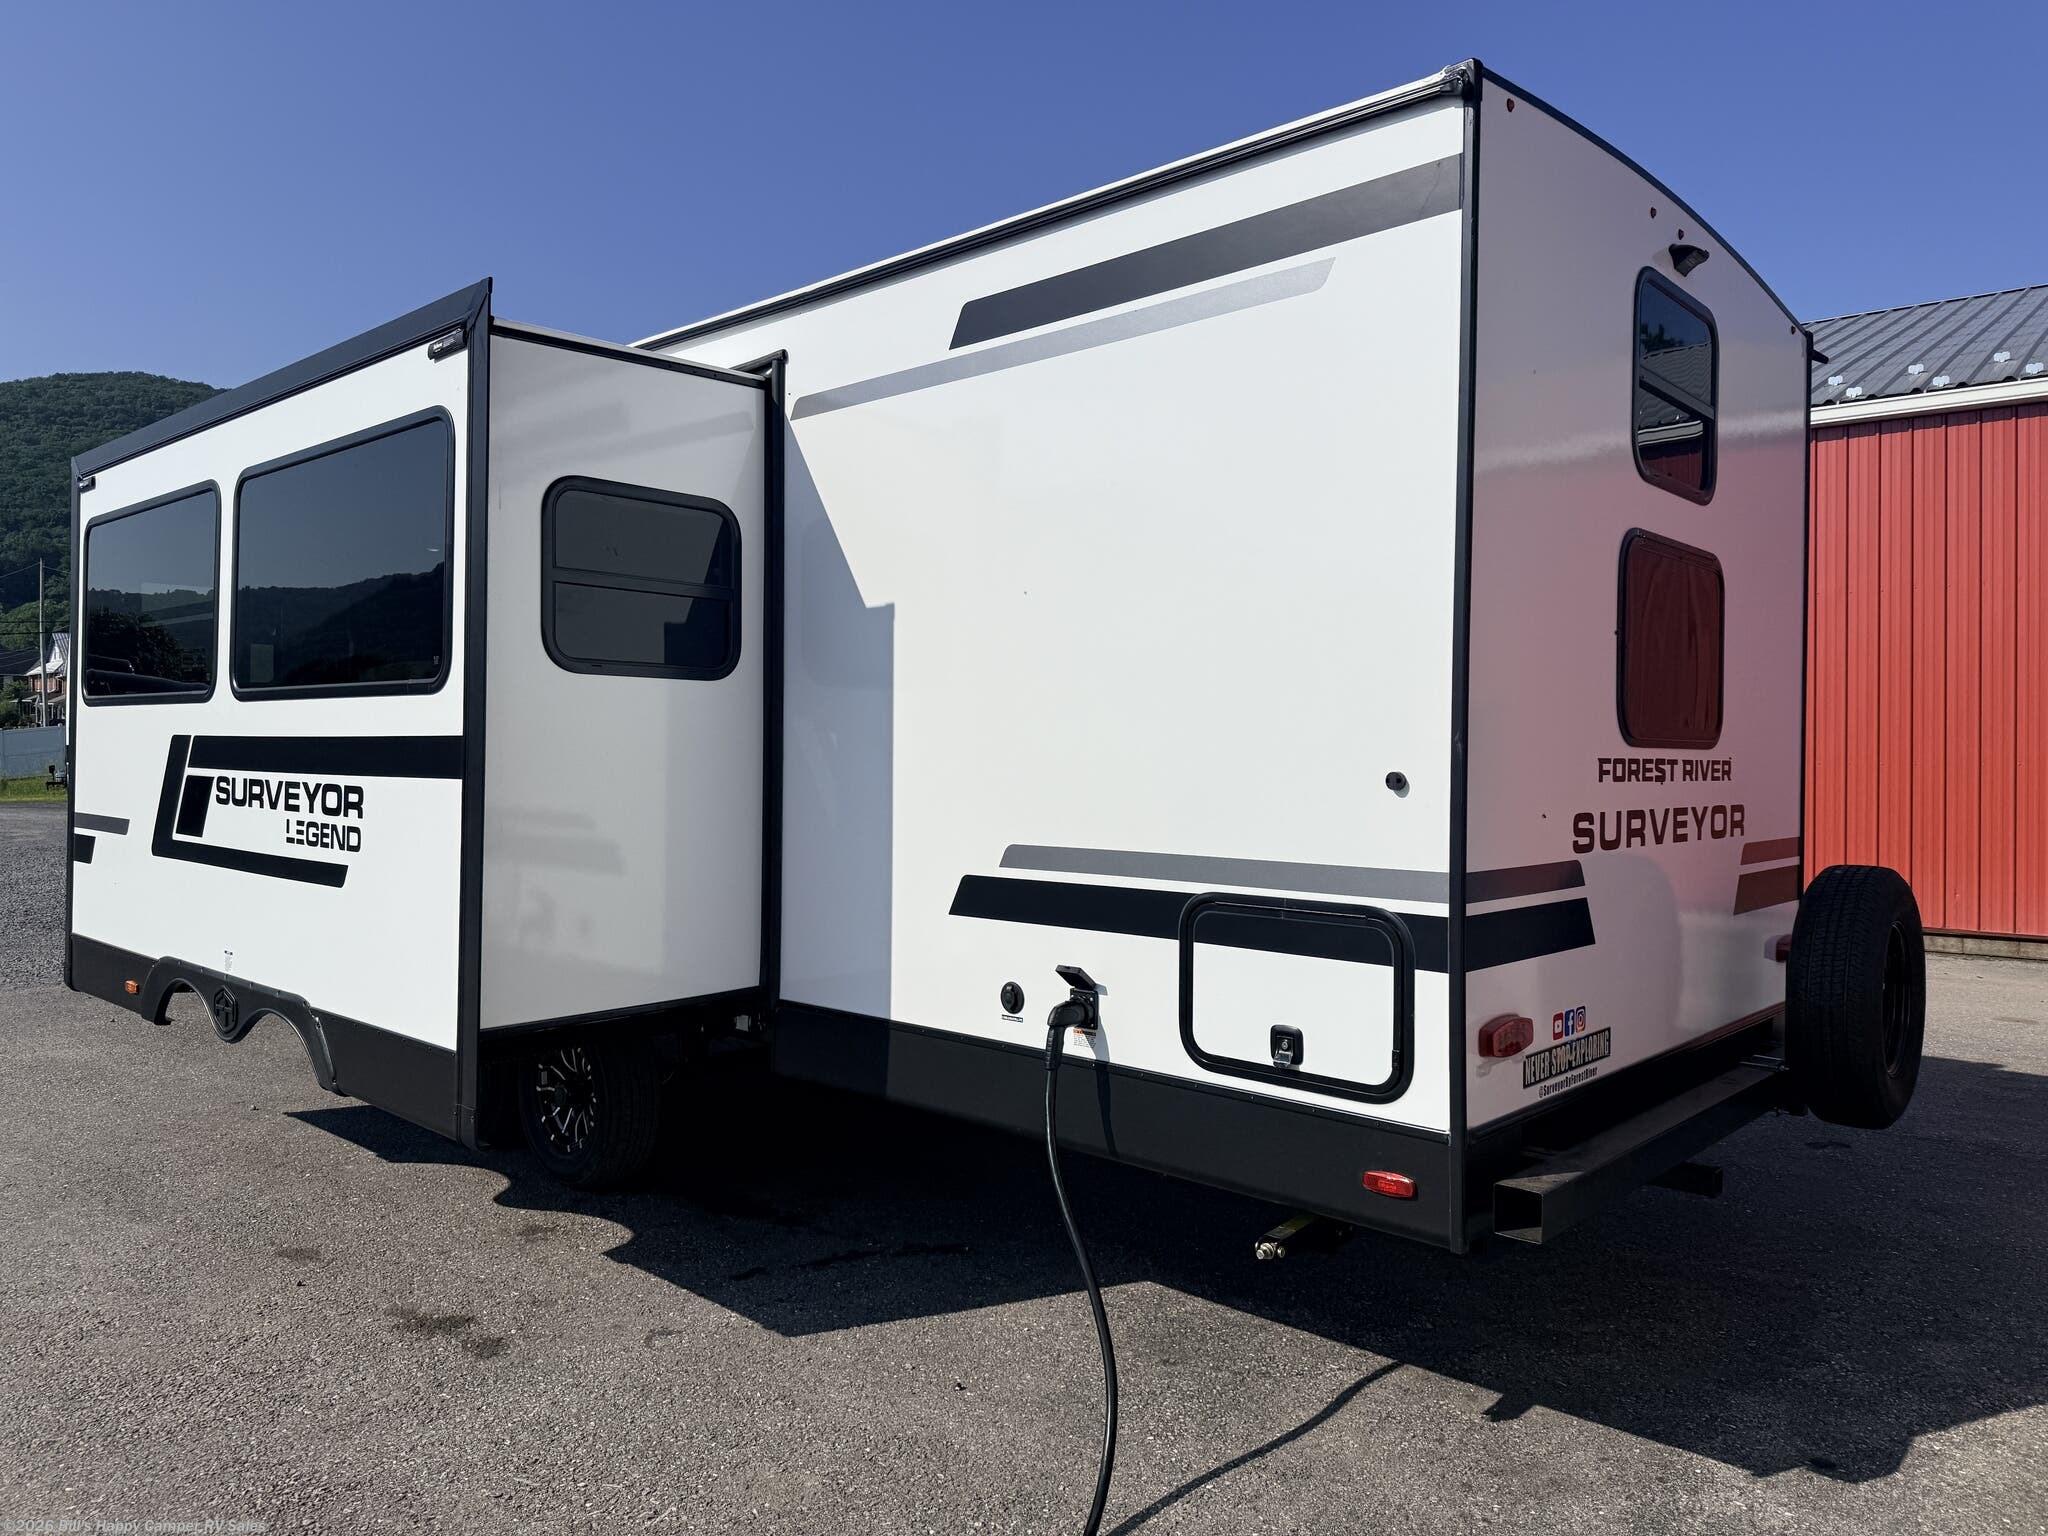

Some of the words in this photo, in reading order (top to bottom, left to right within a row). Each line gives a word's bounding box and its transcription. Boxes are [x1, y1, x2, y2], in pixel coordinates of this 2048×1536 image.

[1598, 758, 1678, 783] FOREST
[1682, 758, 1732, 782] RIVER
[215, 775, 364, 819] SURVEYOR
[286, 818, 361, 853] LEGEND
[1572, 804, 1745, 854] SURVEYOR
[1525, 1050, 1550, 1086] NEVER
[1551, 1043, 1571, 1075] STOP
[1571, 1030, 1609, 1068] EXPLORING
